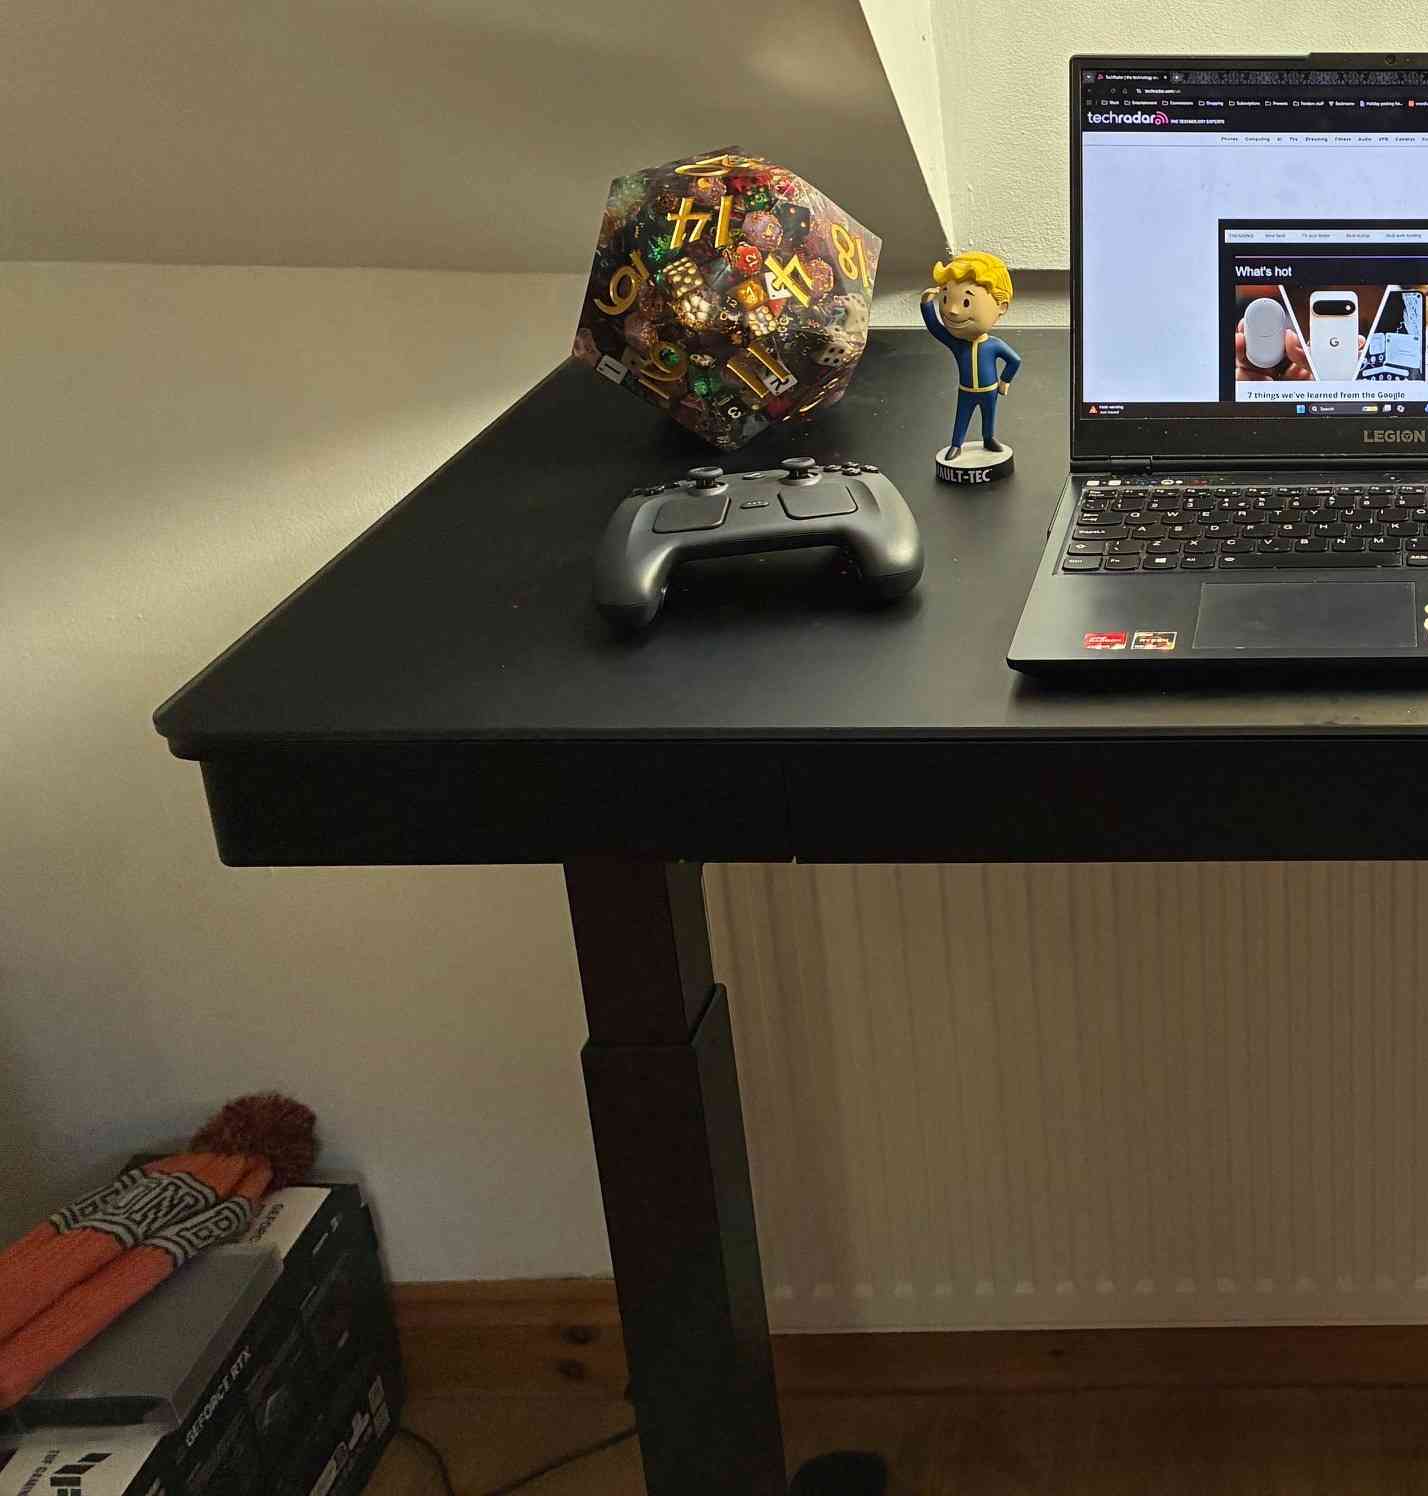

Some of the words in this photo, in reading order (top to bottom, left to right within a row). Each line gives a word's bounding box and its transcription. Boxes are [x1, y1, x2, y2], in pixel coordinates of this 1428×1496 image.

[1087, 111, 1156, 124] techradar
[1235, 266, 1272, 277] What's
[1275, 266, 1292, 277] hot
[1248, 391, 1253, 399] 7
[1254, 391, 1280, 401] things
[1281, 391, 1305, 399] we've
[1307, 391, 1337, 399] learned
[1340, 391, 1360, 399] from
[1362, 391, 1375, 399] the
[1377, 391, 1405, 401] Google
[1363, 430, 1426, 443] LEGION
